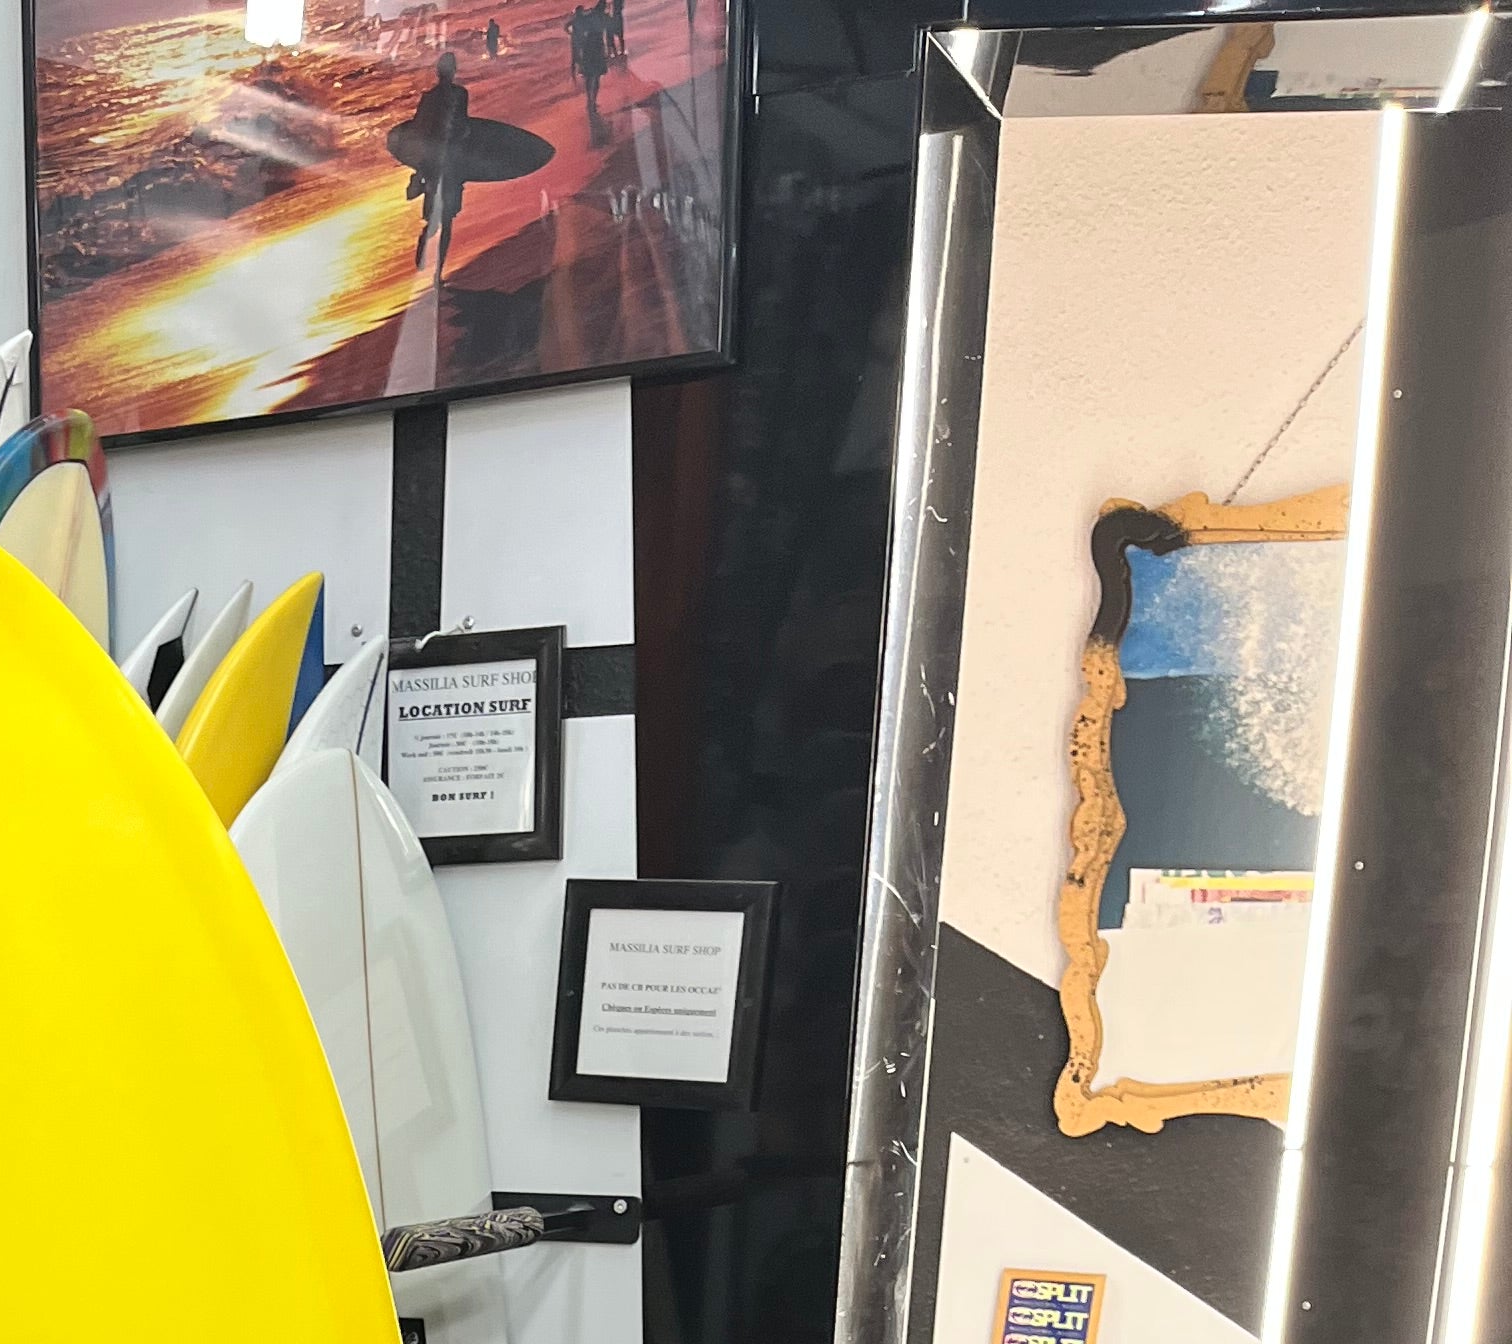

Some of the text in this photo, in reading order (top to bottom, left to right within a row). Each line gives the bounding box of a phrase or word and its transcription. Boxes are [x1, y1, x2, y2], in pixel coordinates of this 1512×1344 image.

[391, 676, 459, 694] MASSILIA
[462, 672, 499, 689] SURF
[398, 698, 532, 719] LOCATION SURF
[431, 793, 456, 802] BON
[459, 791, 488, 801] SURF
[609, 942, 722, 956] MASSILIA SURF SHOP
[601, 982, 617, 990] PAS
[645, 984, 669, 992] POUR
[670, 985, 686, 993] LES
[1037, 1282, 1093, 1304] SPLIT
[1033, 1308, 1089, 1331] SPLIT
